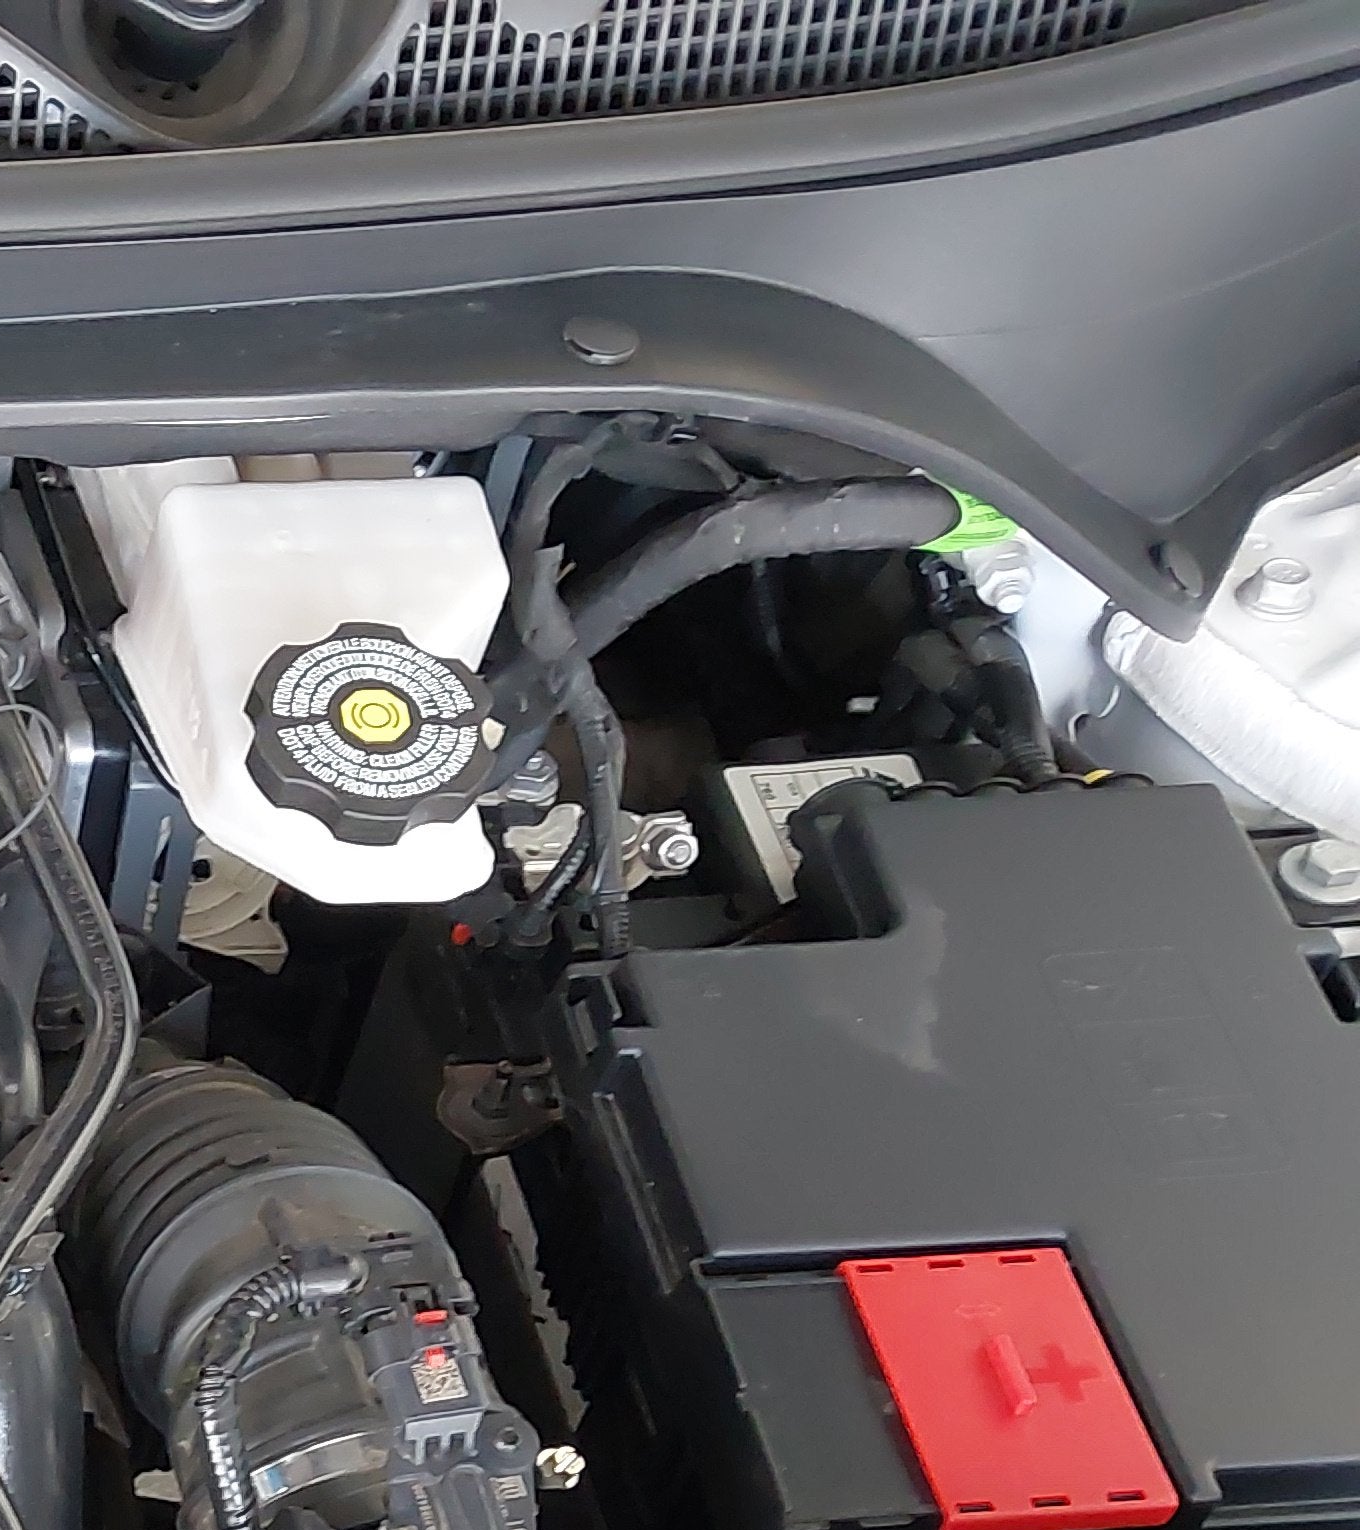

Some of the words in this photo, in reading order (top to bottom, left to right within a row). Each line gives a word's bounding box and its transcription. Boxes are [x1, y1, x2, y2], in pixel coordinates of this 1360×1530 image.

[275, 727, 305, 754] DOT
[289, 746, 310, 760] 4
[296, 752, 339, 785] FLUID
[332, 773, 377, 797] FROM
